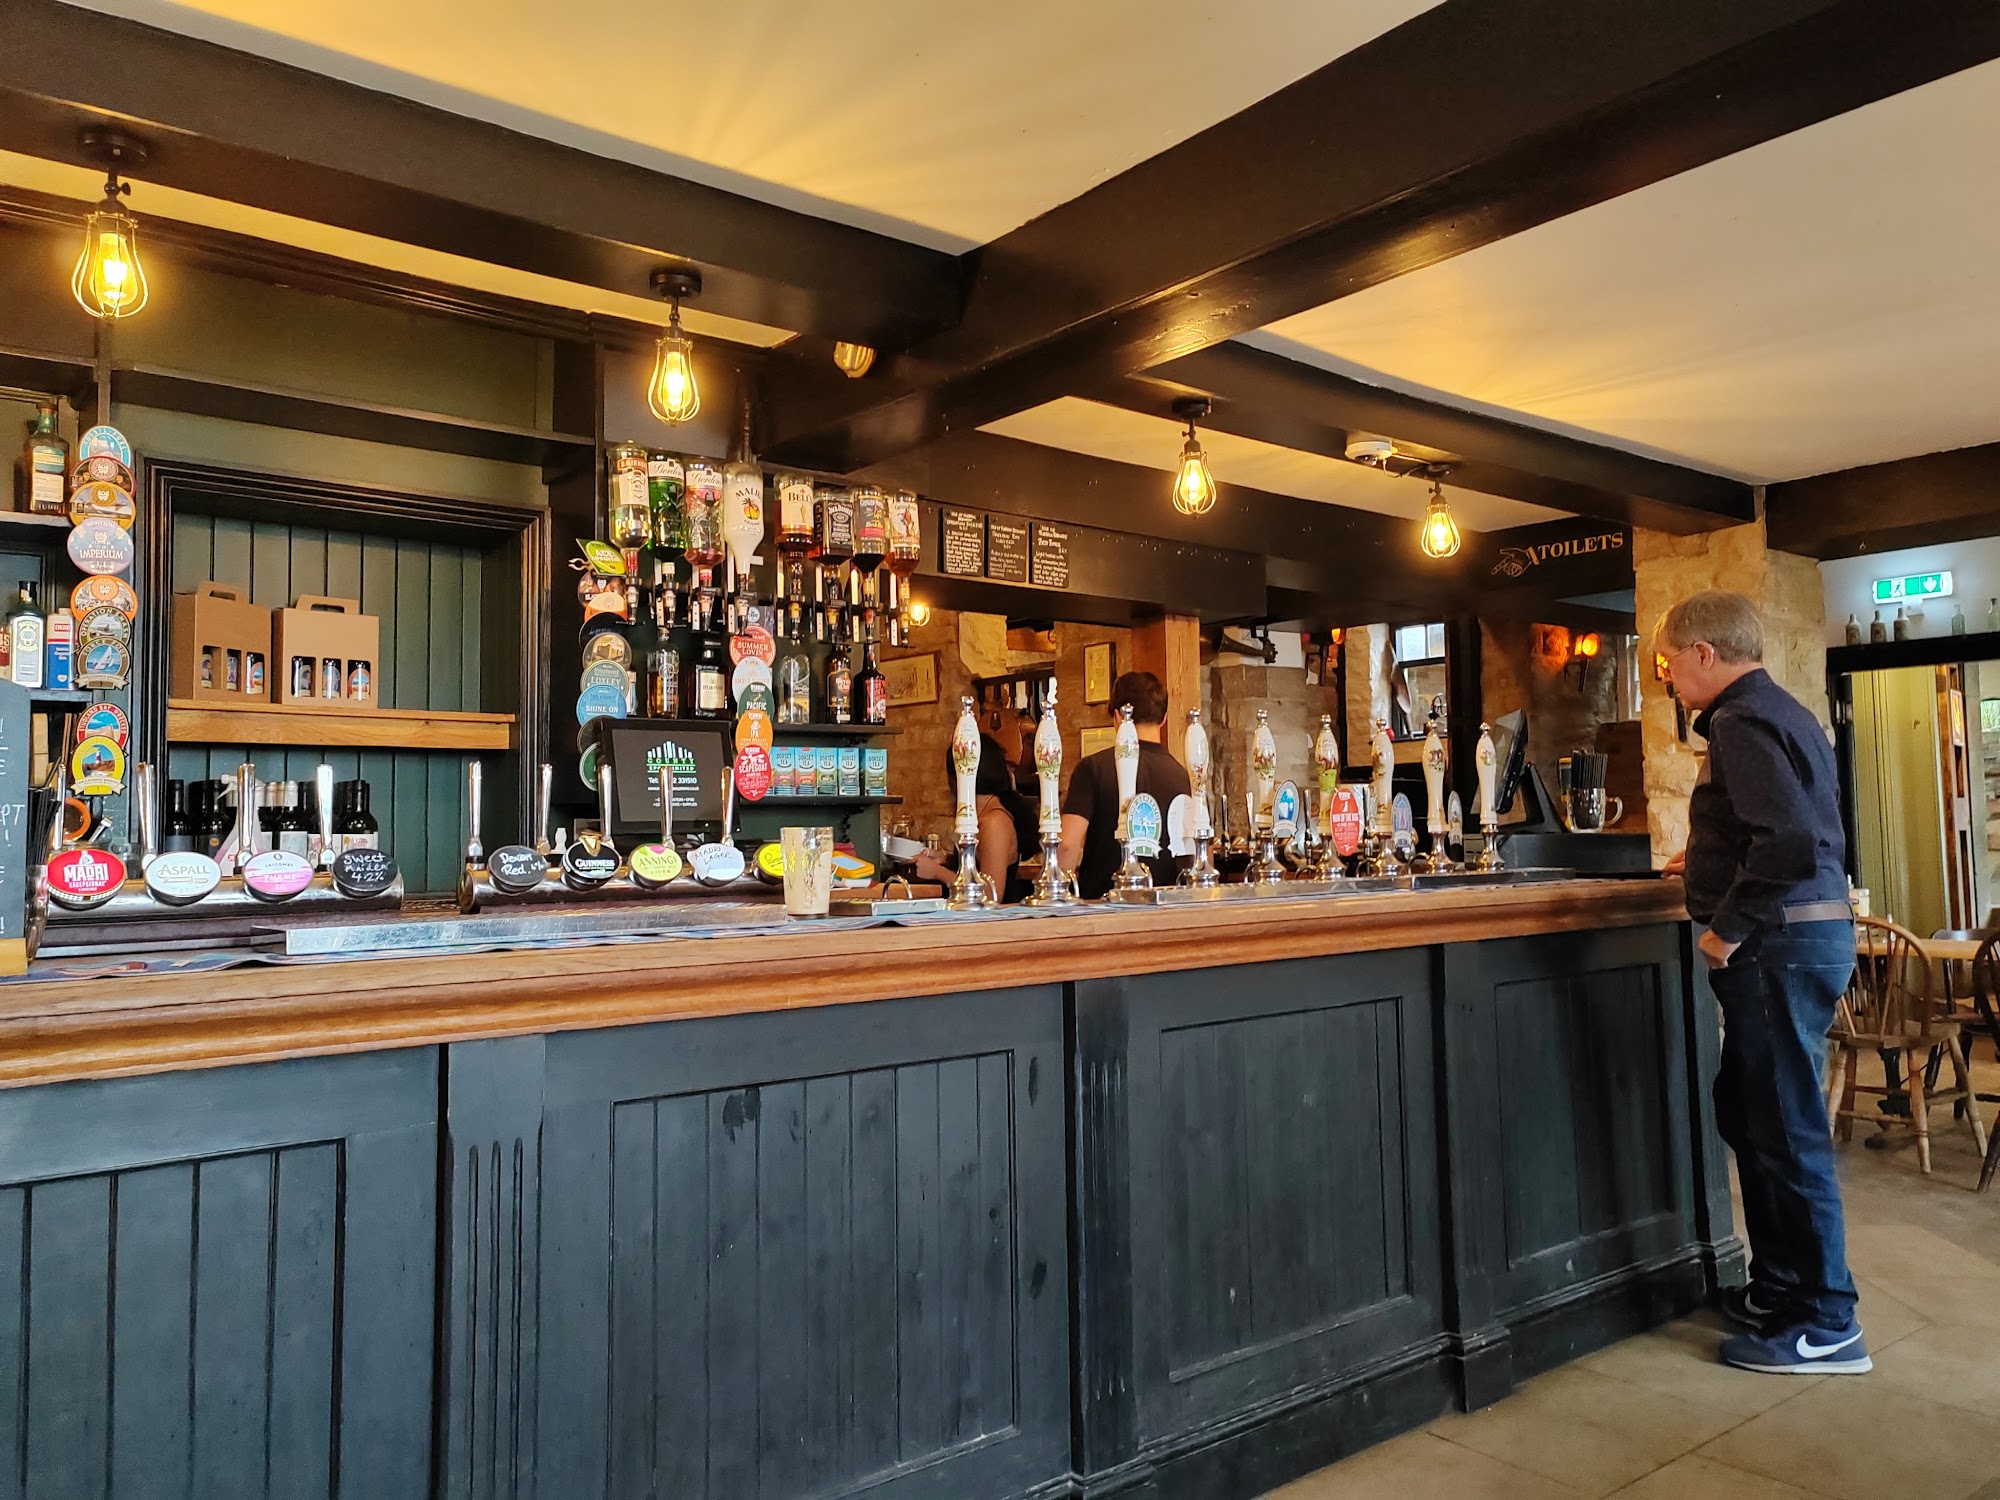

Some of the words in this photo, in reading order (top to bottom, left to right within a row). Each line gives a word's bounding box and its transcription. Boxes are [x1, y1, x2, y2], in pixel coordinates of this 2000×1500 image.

[1537, 532, 1624, 560] TOILETS
[79, 548, 123, 560] IMPERIUM
[80, 608, 113, 637] OPERATION
[737, 641, 769, 651] SUMMER
[590, 676, 621, 686] LOXLEY
[585, 705, 607, 713] SHINE
[746, 701, 767, 710] PACIFIC
[750, 730, 759, 738] IPA
[738, 763, 768, 774] SCAPEGOAT
[694, 845, 722, 860] MADRI
[703, 851, 732, 865] LAGER
[575, 858, 615, 868] GUINNESS
[157, 864, 210, 878] ASPALL
[351, 871, 384, 882] 4.2%
